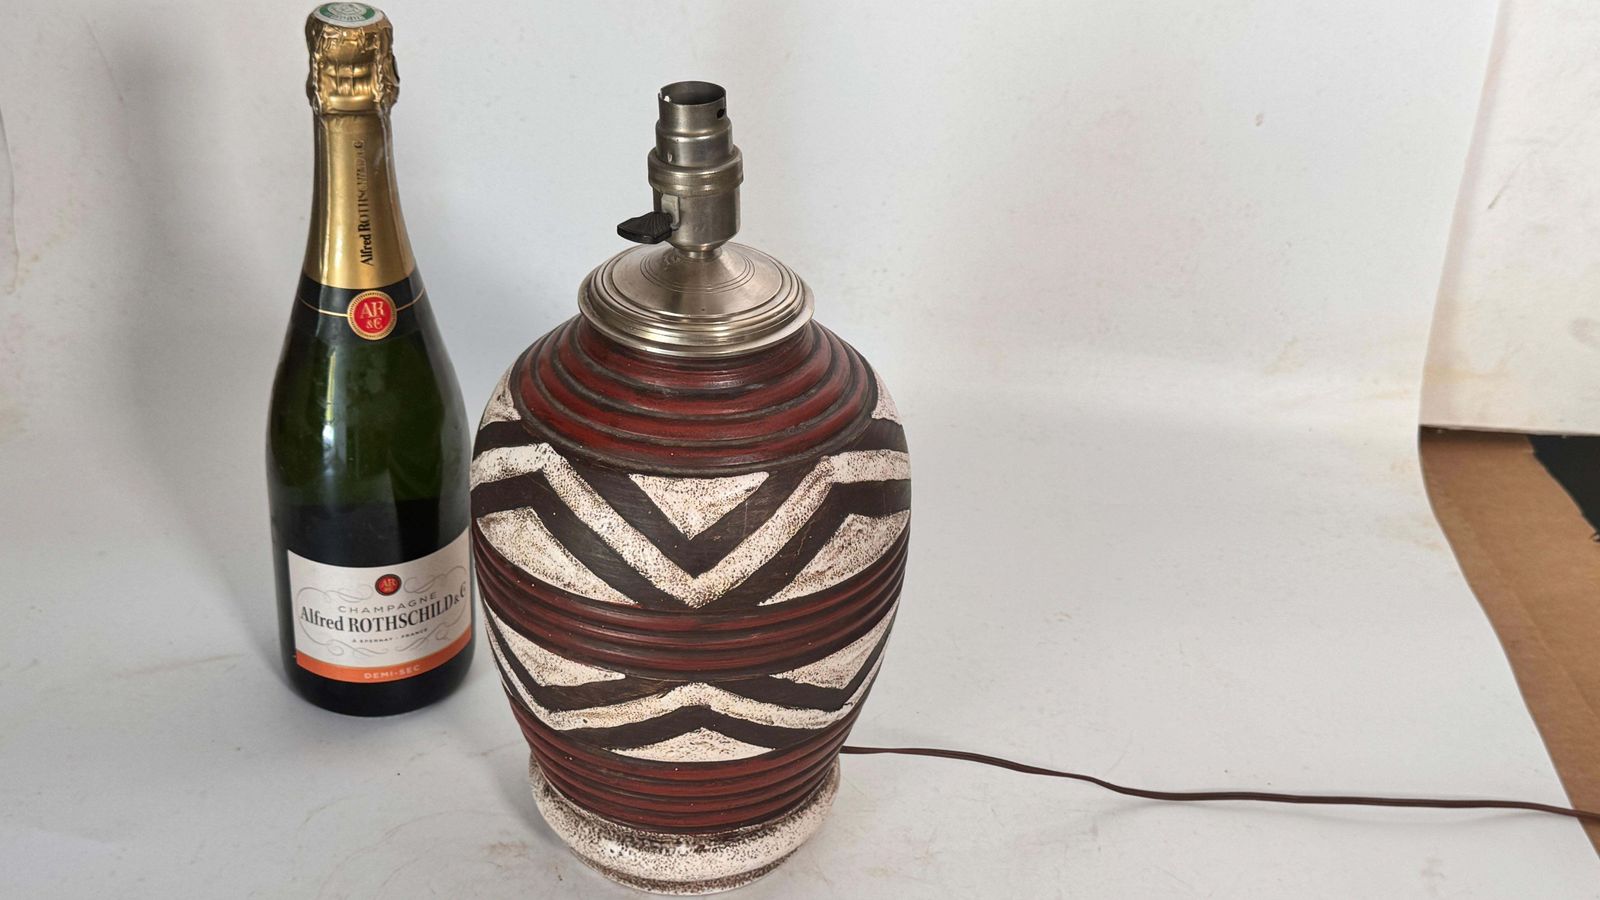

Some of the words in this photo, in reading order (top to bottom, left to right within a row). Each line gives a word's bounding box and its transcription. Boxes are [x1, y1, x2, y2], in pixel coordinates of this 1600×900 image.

[360, 234, 375, 267] Alfred
[360, 300, 385, 318] AR
[338, 591, 437, 613] CHAMPAGNE
[300, 606, 344, 631] Alfred
[349, 594, 453, 633] ROTHSCHILD
[363, 664, 420, 679] DEMI-SEC
